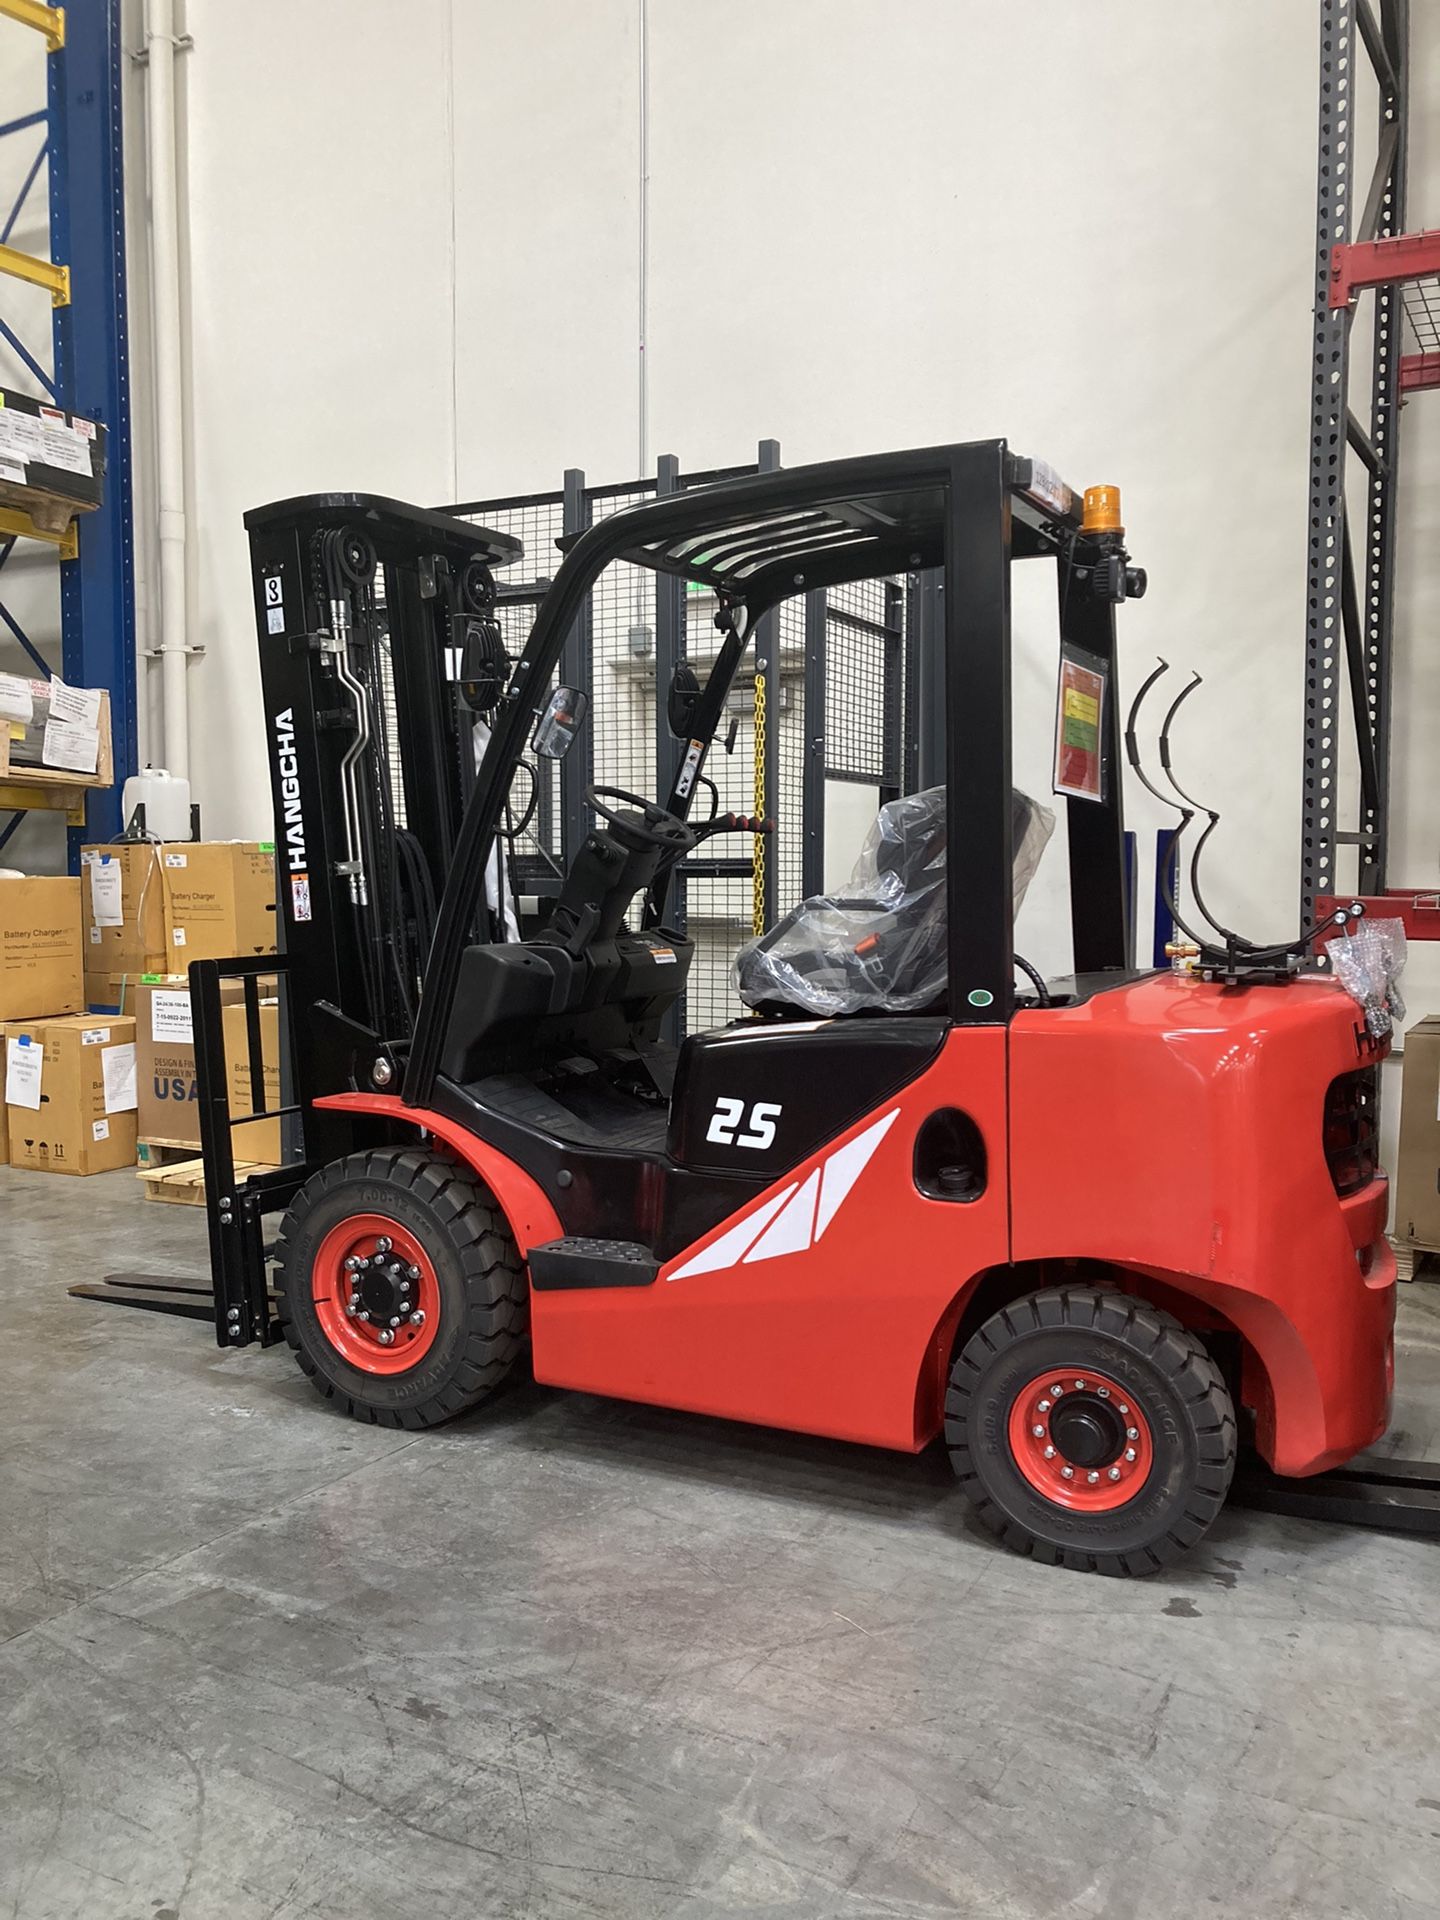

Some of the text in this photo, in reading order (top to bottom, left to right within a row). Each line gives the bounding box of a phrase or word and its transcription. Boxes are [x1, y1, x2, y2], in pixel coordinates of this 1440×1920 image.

[275, 707, 307, 870] HANGCHA
[192, 892, 216, 902] Charger
[4, 929, 63, 939] Battery Charger
[154, 1057, 178, 1067] DESIGN
[154, 1067, 184, 1077] ASSEMBLY
[154, 1076, 199, 1102] USA
[705, 1096, 783, 1150] 25
